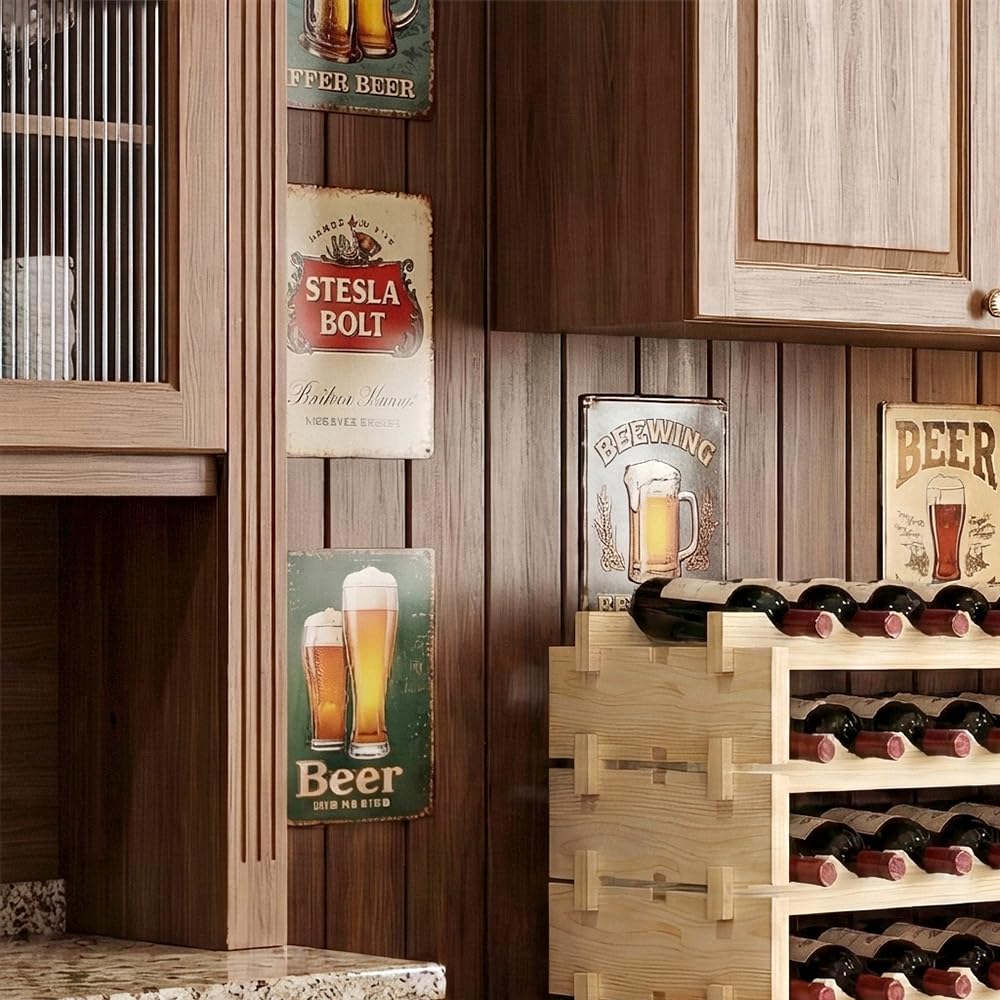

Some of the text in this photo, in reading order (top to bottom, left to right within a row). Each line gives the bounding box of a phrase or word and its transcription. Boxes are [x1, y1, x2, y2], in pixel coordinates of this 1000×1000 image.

[355, 74, 416, 99] BEER
[305, 276, 401, 306] STESLA
[320, 310, 386, 337] BOLT
[594, 418, 717, 468] BEEWING
[896, 420, 998, 491] BEER
[296, 760, 404, 798] Beer
